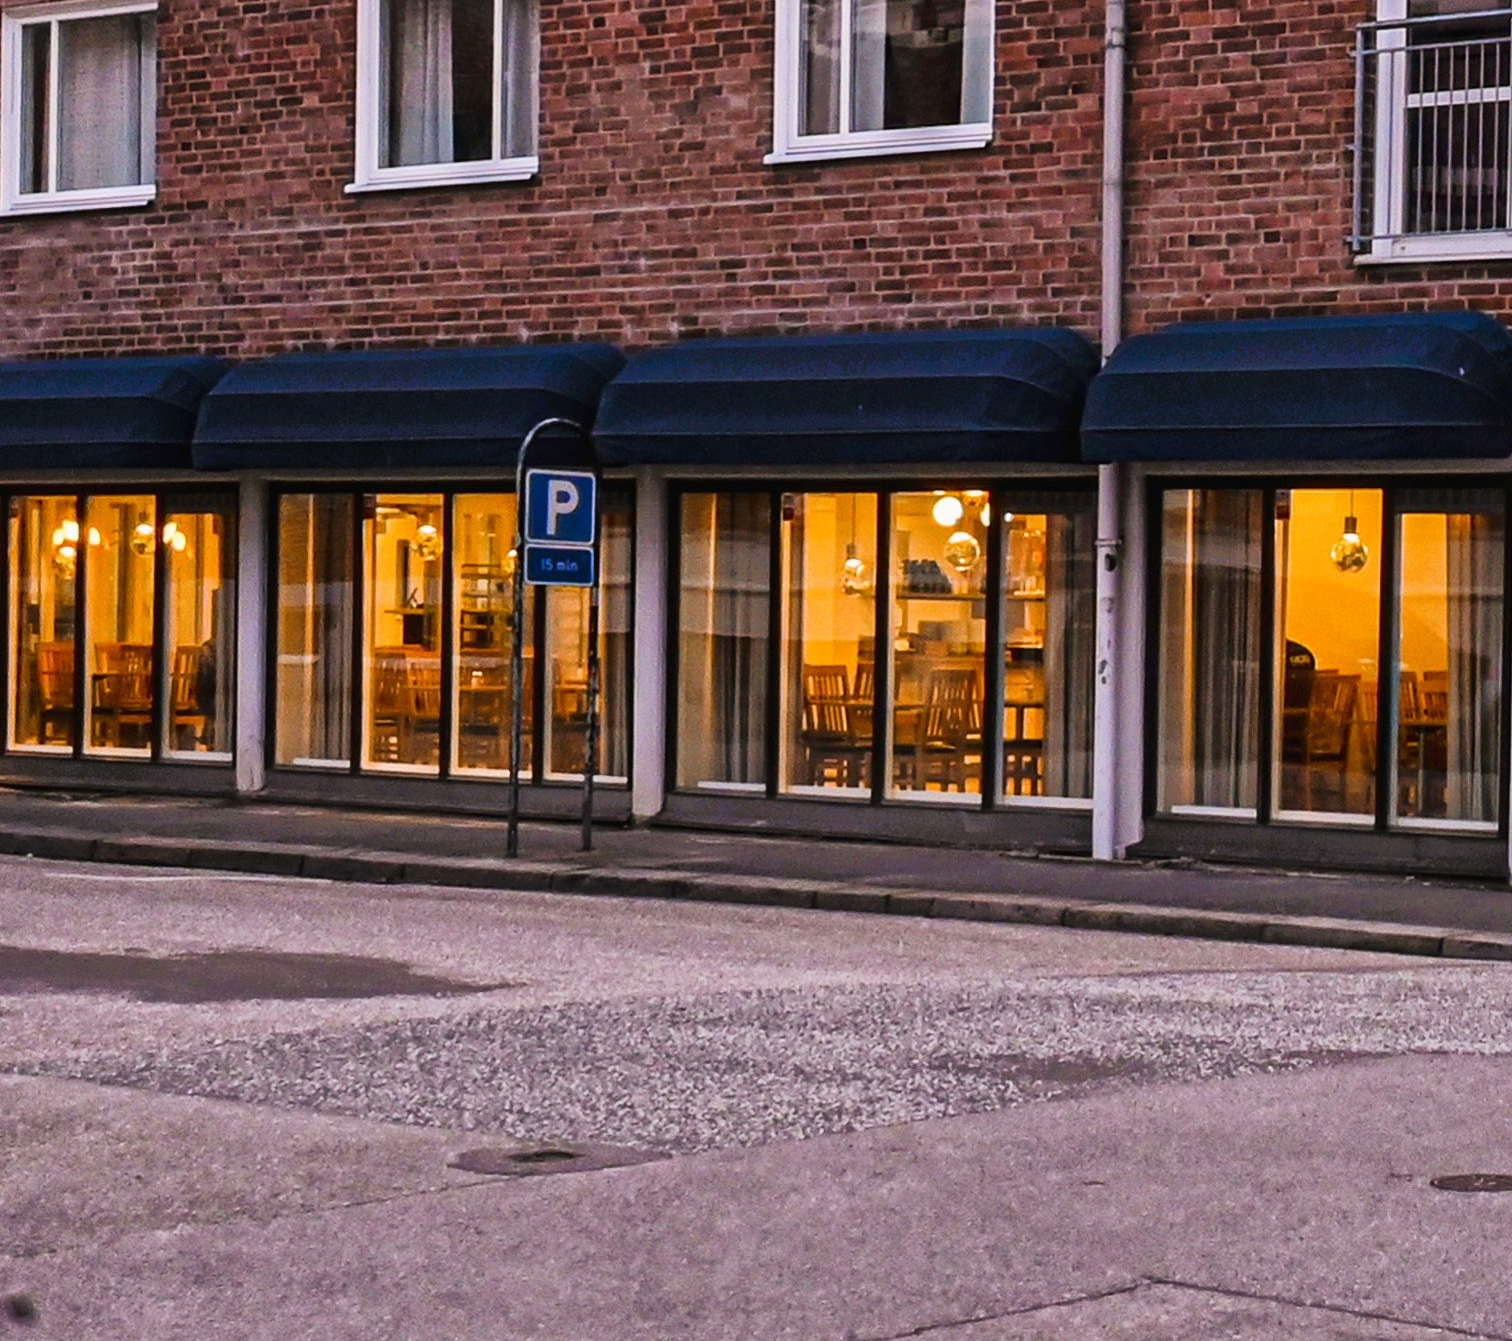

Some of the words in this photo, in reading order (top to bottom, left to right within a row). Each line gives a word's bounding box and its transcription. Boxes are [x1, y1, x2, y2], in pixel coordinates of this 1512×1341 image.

[546, 479, 579, 536] P
[541, 558, 553, 571] 15
[556, 559, 579, 572] min
